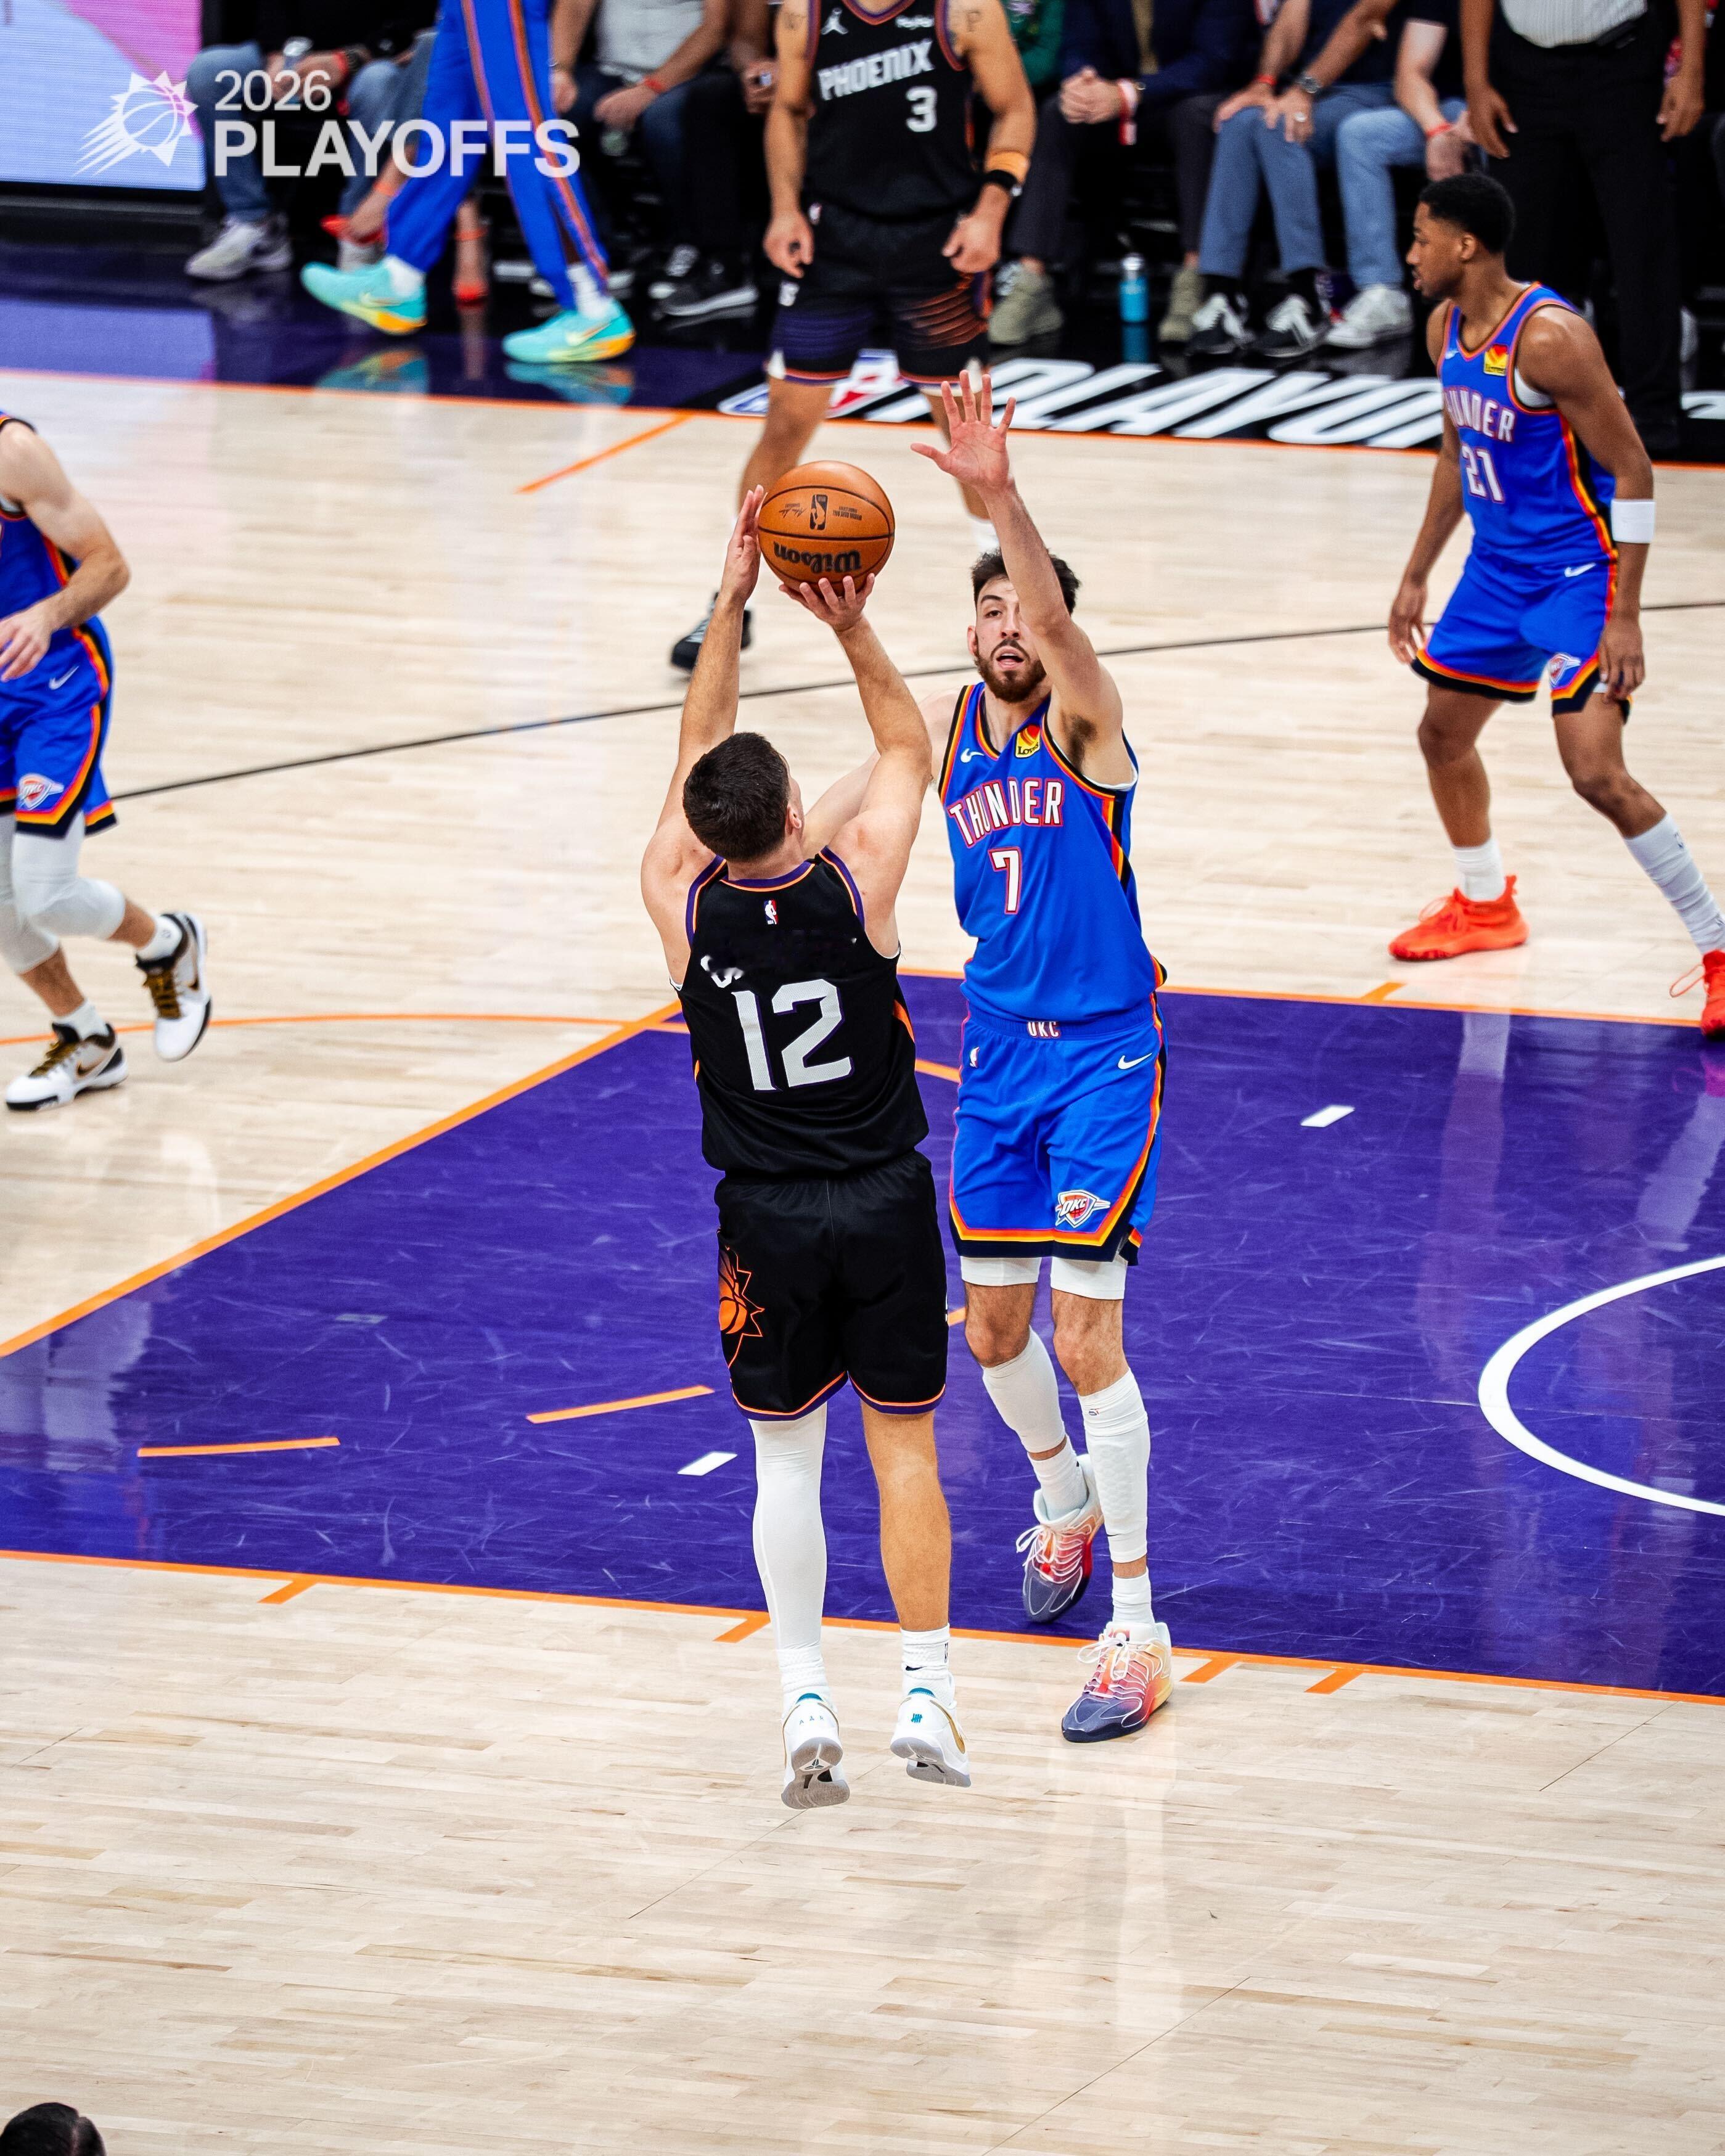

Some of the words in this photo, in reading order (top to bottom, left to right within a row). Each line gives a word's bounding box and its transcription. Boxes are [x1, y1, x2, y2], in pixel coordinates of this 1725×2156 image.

[818, 38, 935, 100] PHOENIX
[906, 85, 938, 133] 3
[1461, 443, 1505, 504] 21
[773, 540, 861, 573] Wilson
[948, 777, 1064, 848] THUNDER
[988, 846, 1022, 914] 7
[731, 978, 854, 1091] 12
[1027, 1020, 1060, 1038] OKC
[1059, 1198, 1088, 1217] OKC
